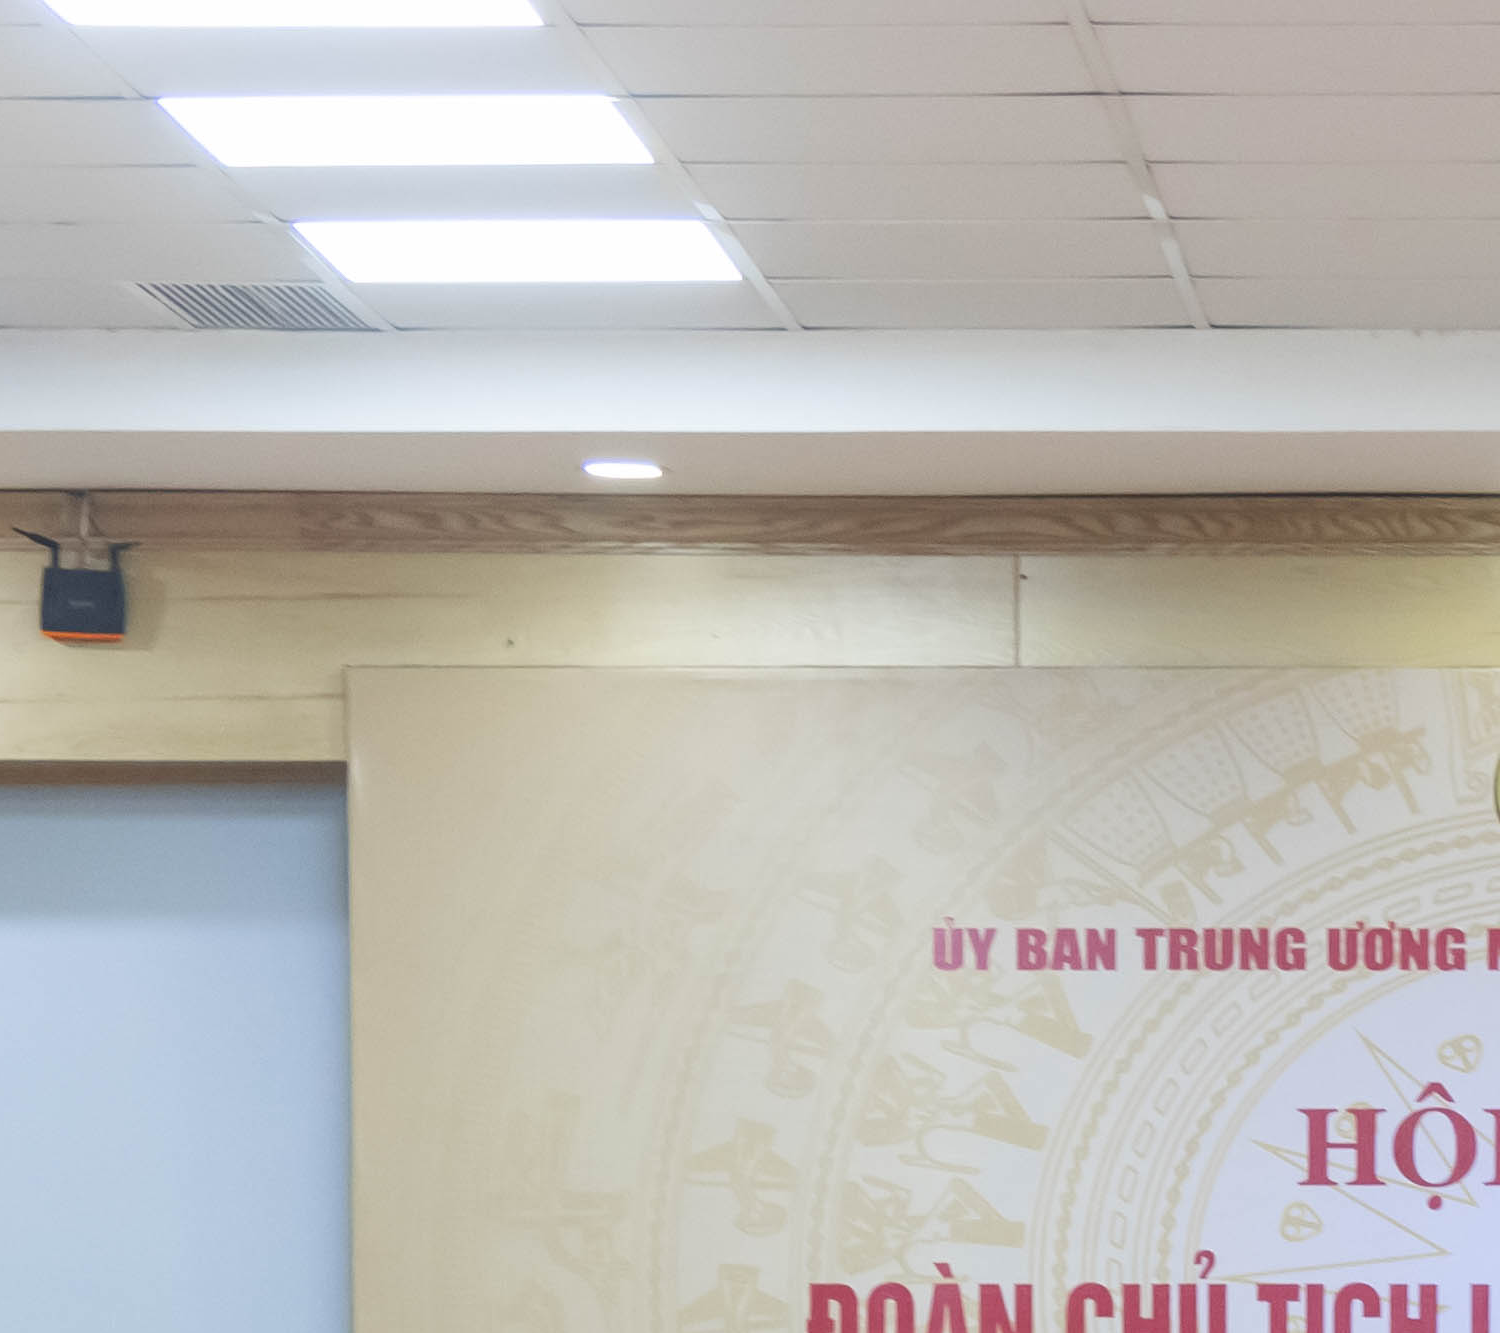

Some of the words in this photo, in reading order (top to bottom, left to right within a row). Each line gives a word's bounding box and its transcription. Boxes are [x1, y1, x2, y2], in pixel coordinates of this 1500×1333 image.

[932, 917, 997, 971] ỦY
[1016, 927, 1117, 971] BAN
[1135, 926, 1308, 971] TRUNG
[1326, 920, 1468, 972] ƯƠNG
